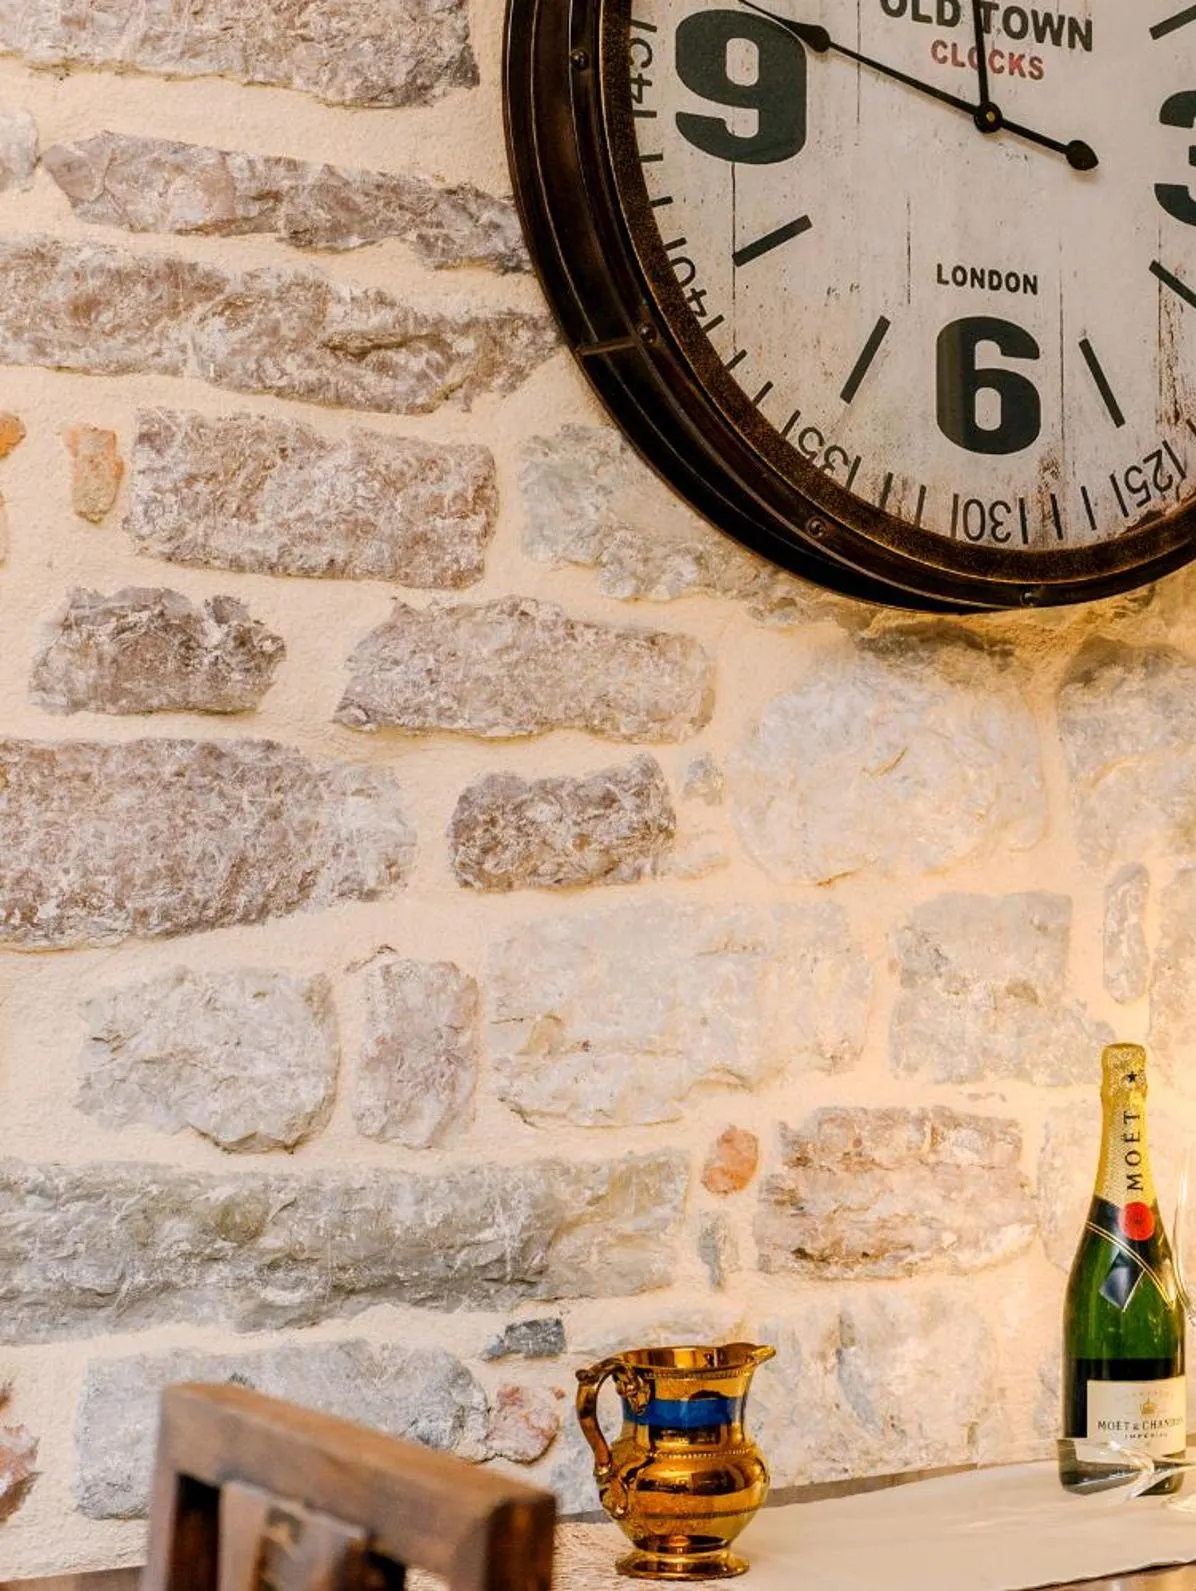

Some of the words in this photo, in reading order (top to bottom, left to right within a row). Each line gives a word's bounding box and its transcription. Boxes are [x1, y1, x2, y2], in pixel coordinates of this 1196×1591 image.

[880, 0, 961, 28] OLD
[979, 2, 1093, 52] TOWN
[931, 40, 1045, 80] CLOCKS
[675, 9, 807, 165] 9
[936, 263, 1038, 295] LONDON
[936, 316, 1042, 455] 6
[1123, 449, 1174, 508] 25
[962, 498, 1012, 544] 30
